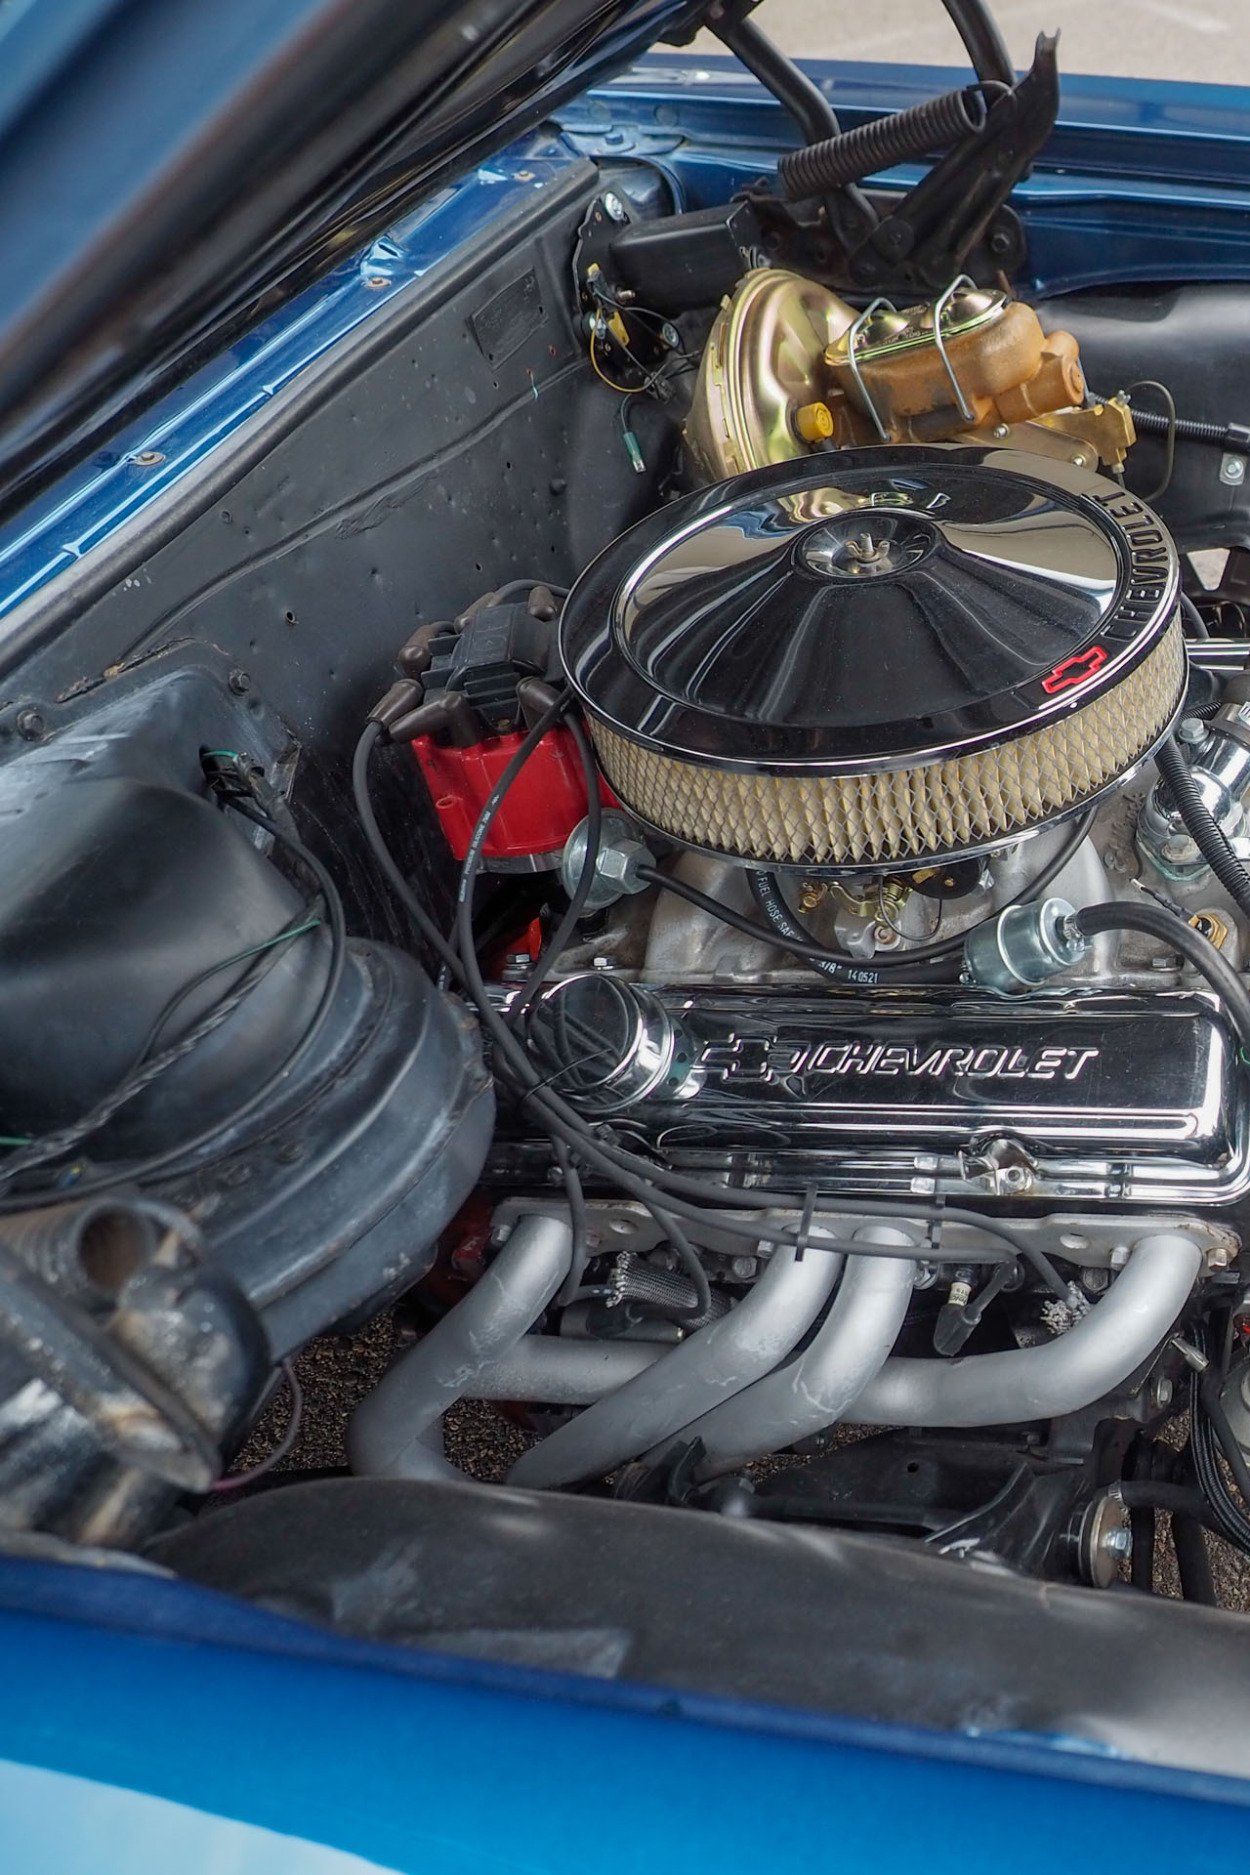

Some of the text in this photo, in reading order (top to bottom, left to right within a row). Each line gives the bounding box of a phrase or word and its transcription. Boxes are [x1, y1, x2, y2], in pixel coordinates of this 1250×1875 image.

[1091, 490, 1169, 643] CHEVROLET
[757, 876, 771, 898] FUEL
[765, 900, 783, 923] HOSE
[810, 1040, 1099, 1080] CHEVROLET
